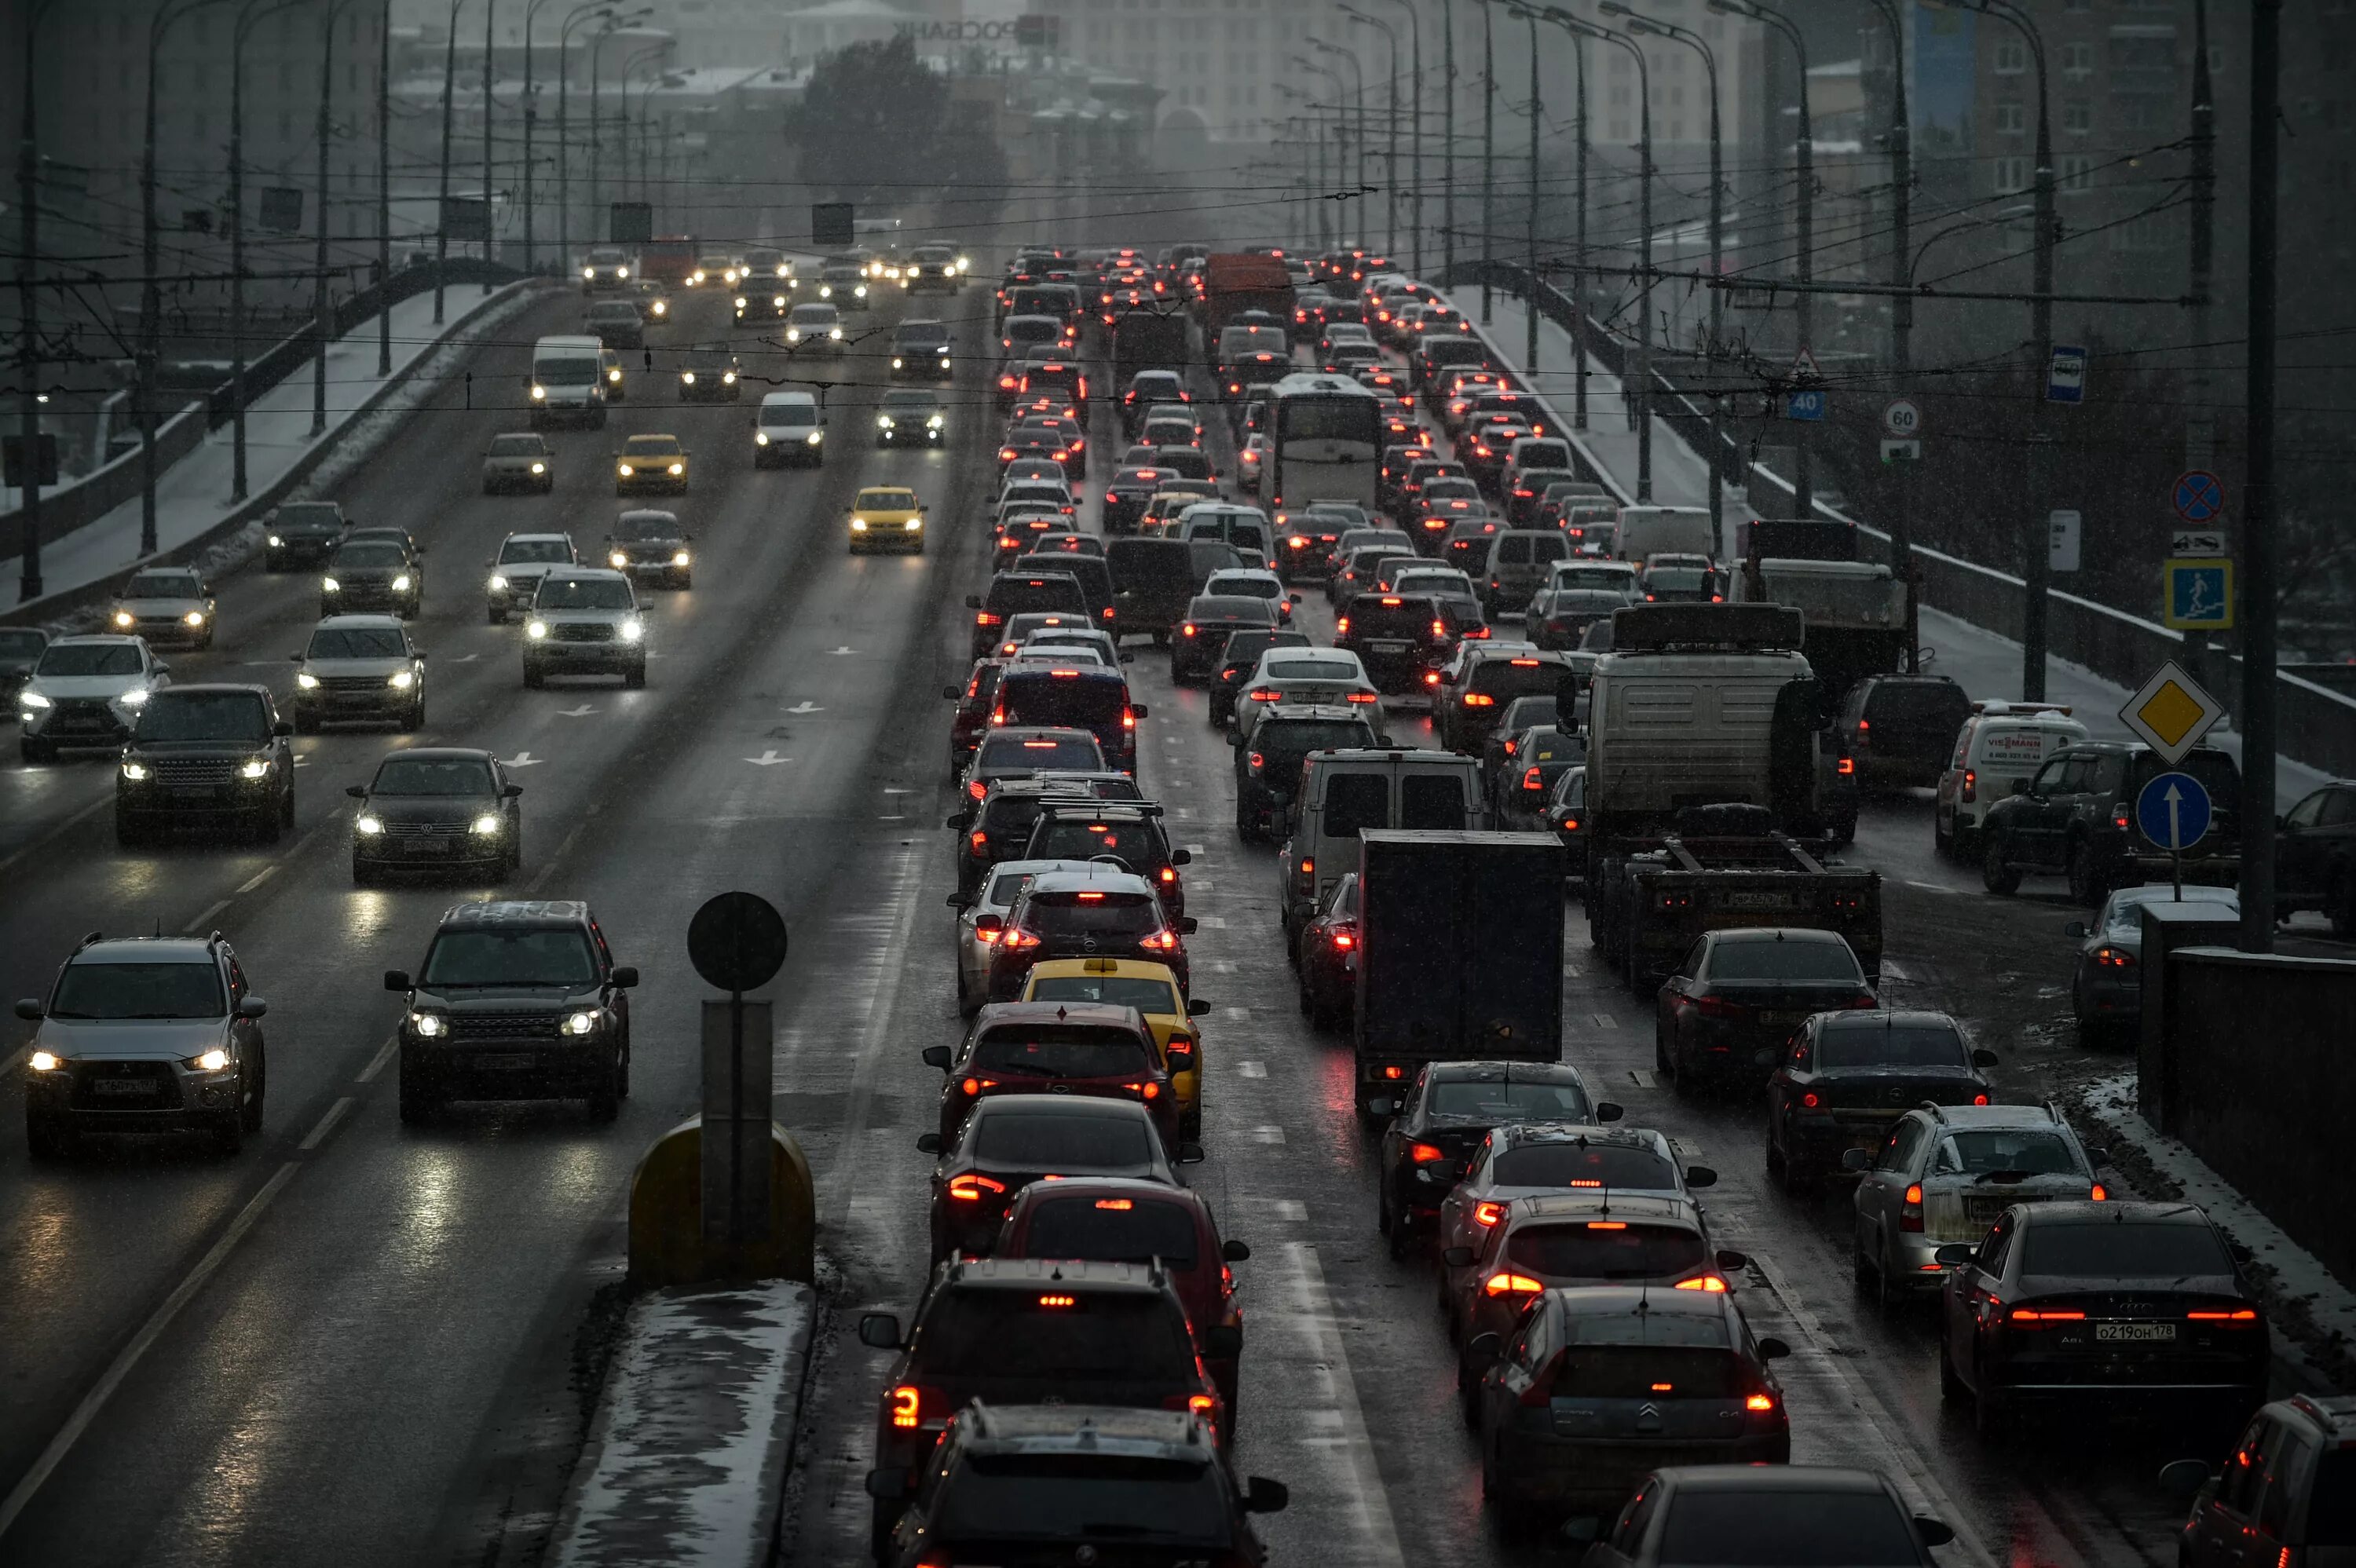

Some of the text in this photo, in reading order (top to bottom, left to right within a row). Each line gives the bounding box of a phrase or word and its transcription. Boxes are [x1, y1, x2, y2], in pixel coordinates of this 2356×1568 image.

[1794, 394, 1816, 411] 40
[1893, 411, 1913, 426] 60
[2100, 1325, 2172, 1339] О219ОН 178
